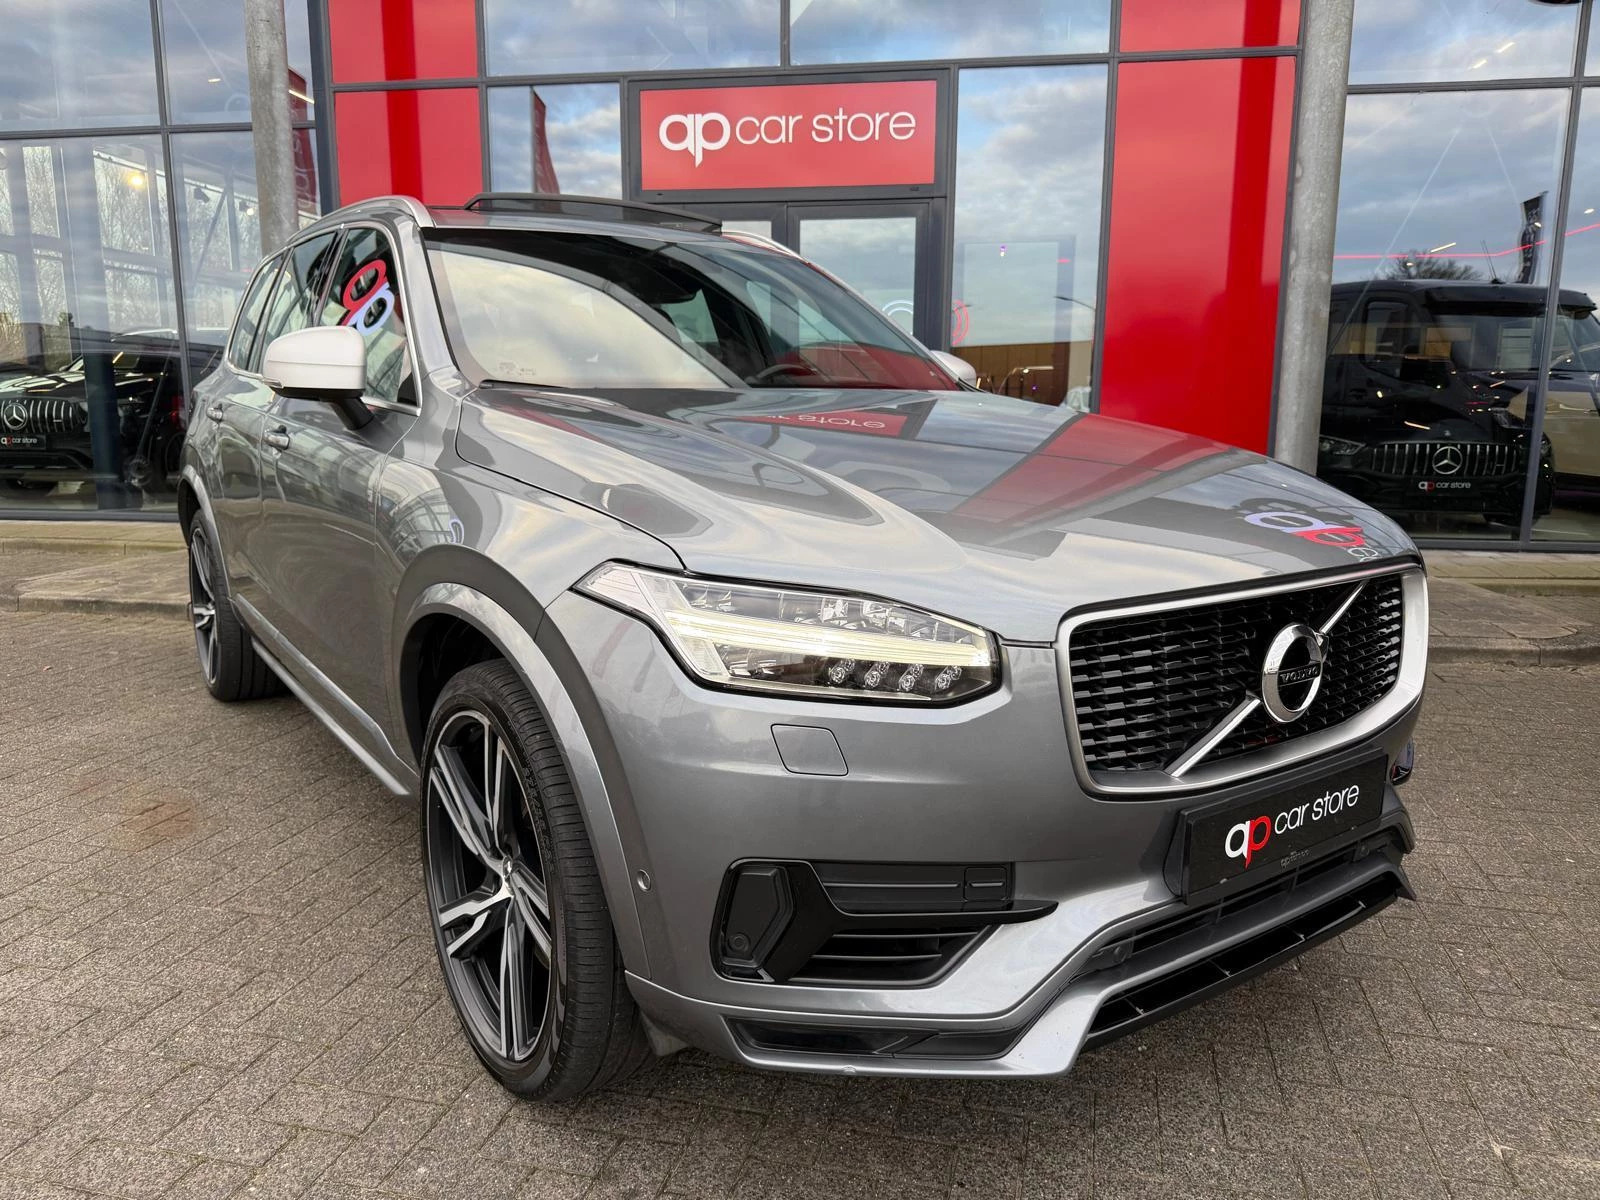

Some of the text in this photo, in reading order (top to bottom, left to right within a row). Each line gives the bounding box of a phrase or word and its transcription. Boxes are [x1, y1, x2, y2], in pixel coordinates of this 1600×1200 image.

[658, 107, 916, 168] ap car store
[1436, 481, 1450, 489] car
[1450, 481, 1471, 489] store
[1279, 665, 1319, 683] VOLVO
[1224, 815, 1272, 869] ap
[1274, 802, 1310, 835] car
[1311, 784, 1360, 821] store
